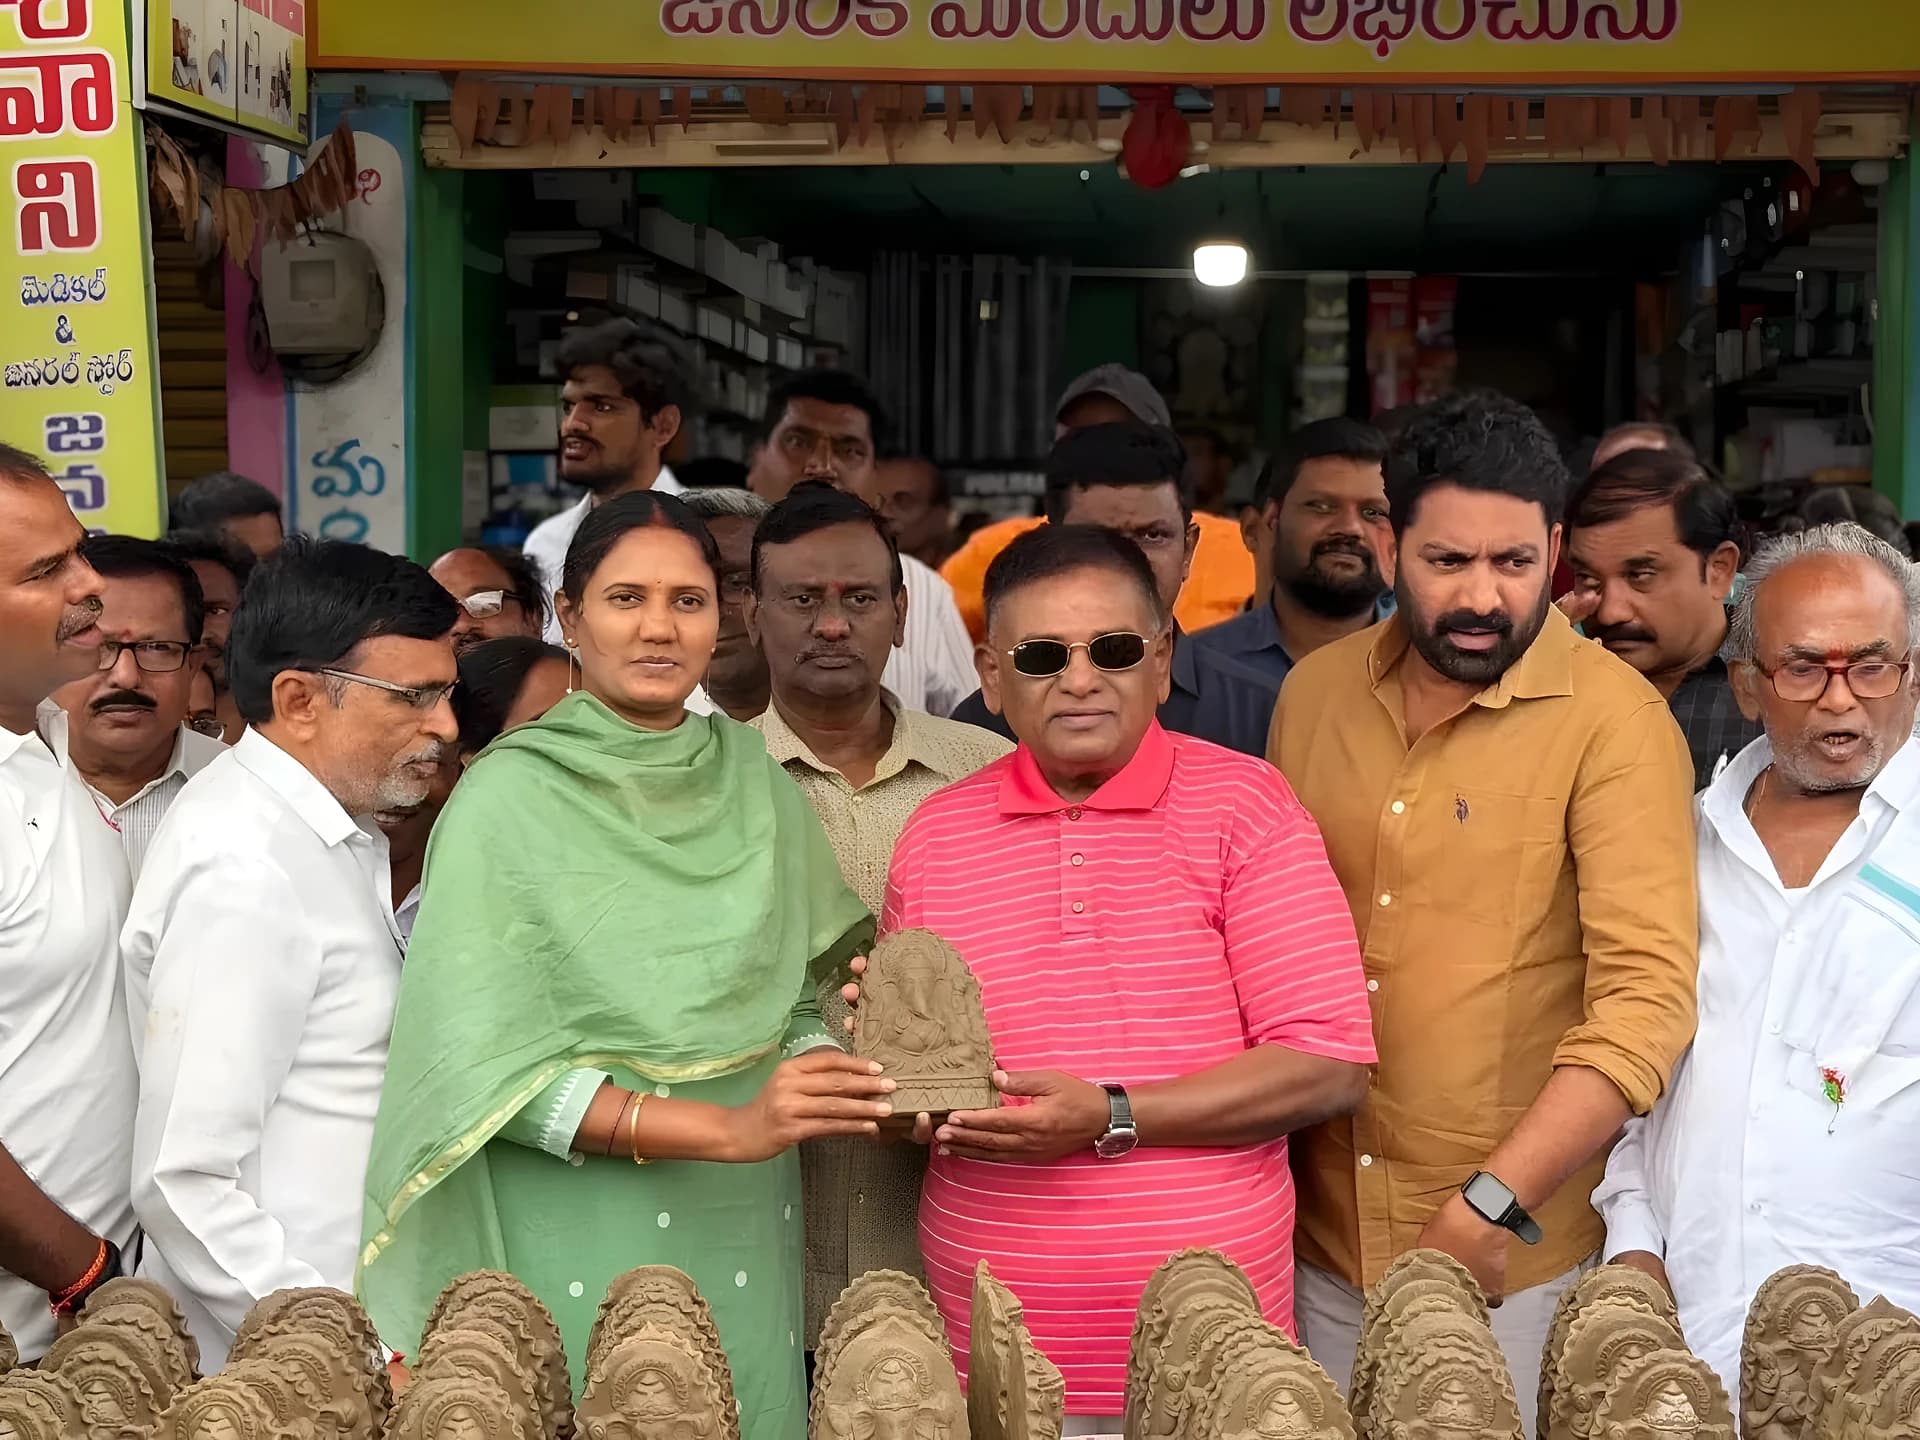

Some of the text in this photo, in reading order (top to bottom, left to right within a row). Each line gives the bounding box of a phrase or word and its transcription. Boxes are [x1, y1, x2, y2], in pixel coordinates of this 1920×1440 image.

[1288, 0, 1678, 58] లభంచును
[21, 268, 107, 305] మెడికల్
[55, 314, 76, 343] &
[5, 352, 81, 387] జనరల్
